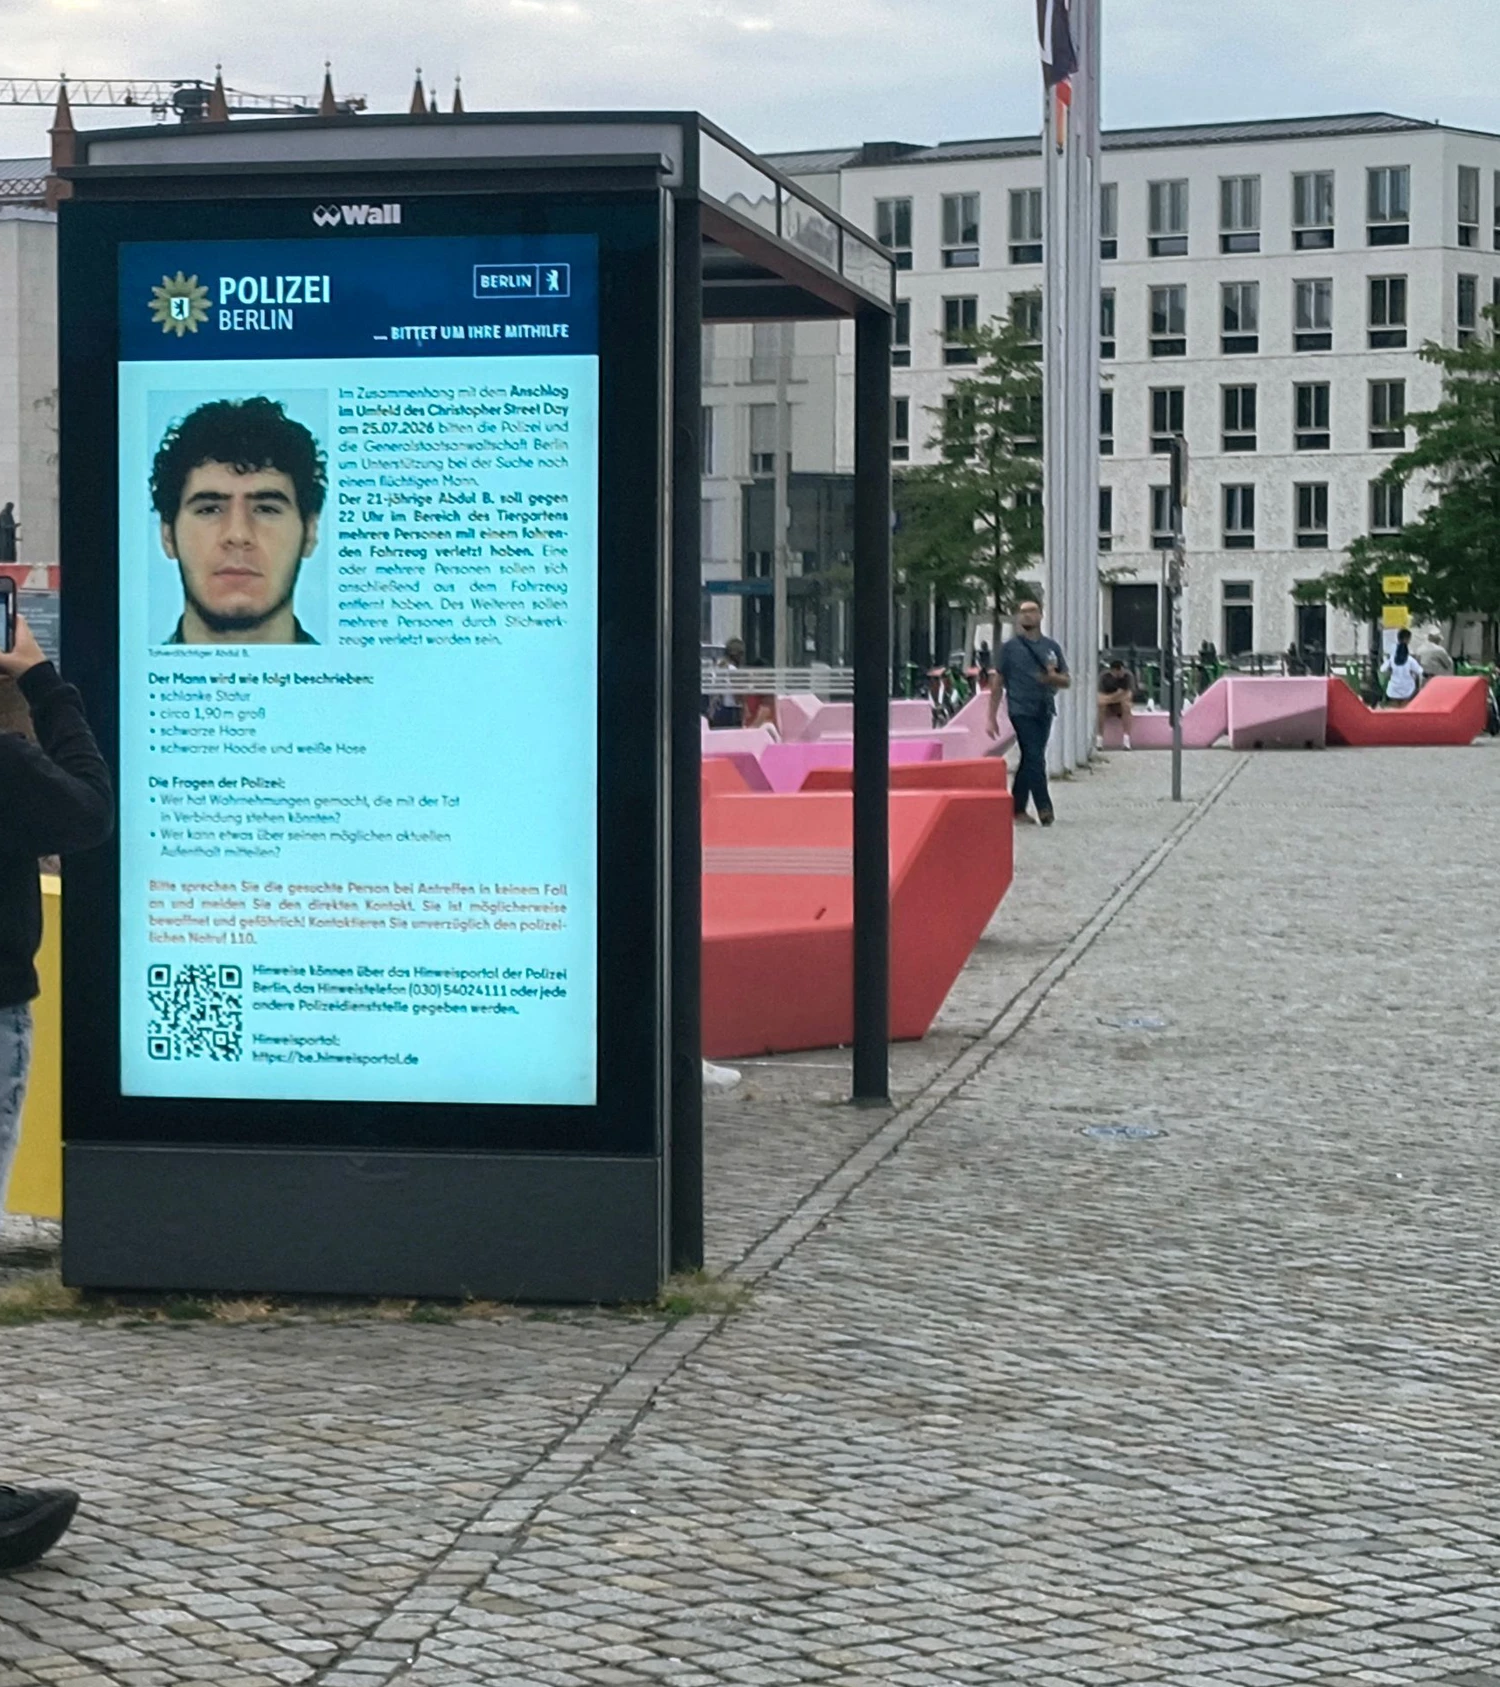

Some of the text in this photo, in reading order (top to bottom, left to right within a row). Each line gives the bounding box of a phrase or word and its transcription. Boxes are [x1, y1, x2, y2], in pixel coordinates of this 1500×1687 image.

[341, 203, 401, 226] Wall
[479, 274, 532, 288] BERLIN
[219, 275, 331, 305] POLIZEI
[219, 309, 293, 331] BERLIN
[391, 326, 437, 340] BITTET
[440, 326, 465, 339] UM
[467, 325, 501, 339] IHRE
[504, 324, 569, 338] MITHILFE
[339, 384, 569, 401] Im Zusammenhang mit dem Anschlag
[338, 402, 569, 418] im Umfeld des Christopher Street Day
[338, 420, 569, 435] am 25.07.2026 bitten die Polizei und
[338, 493, 362, 505] Der
[438, 492, 476, 504] Abdul
[500, 491, 523, 503] soll
[528, 494, 568, 506] gegen
[339, 509, 568, 524] 22 Uhr im Bereich des Tiergartens
[338, 528, 390, 540] mehrere
[394, 527, 452, 540] Personen
[455, 527, 476, 539] mit
[479, 528, 518, 539] einem
[338, 546, 362, 557] den
[369, 545, 427, 560] Fahrzeug
[435, 545, 482, 557] verletzt
[541, 544, 568, 556] Eine
[147, 672, 170, 684] Der
[173, 672, 207, 684] Mann
[209, 673, 236, 684] wird
[238, 673, 259, 684] wie
[262, 672, 291, 687] folgt
[159, 689, 251, 702] schlanke Statur
[159, 708, 190, 719] circa
[159, 725, 257, 736] schwarze Haare
[159, 742, 367, 754] schwarzer Hoodie und weiße Hose
[148, 776, 169, 788] Die
[172, 776, 215, 791] Fragen
[218, 777, 238, 788] der
[159, 828, 451, 844] Wer kann etwas über seinen möglichen aktuellen
[150, 880, 568, 896] Bitte sprechen Sie die gesuchte Person bei Antreffen in keinem Fall
[149, 900, 164, 909] an
[172, 898, 193, 909] und
[202, 898, 245, 910] meiden
[252, 898, 271, 910] Sie
[279, 898, 301, 910] den
[308, 899, 358, 911] direkten
[423, 899, 441, 911] Sie
[448, 900, 462, 911] ist
[470, 900, 567, 915] möglicherweise
[149, 914, 209, 926] bewaffnet
[214, 915, 235, 927] und
[309, 916, 386, 928] Kontaktieren
[389, 917, 407, 928] Sie
[411, 917, 490, 932] unverzüglich
[494, 918, 516, 930] den
[149, 932, 185, 943] lichen
[190, 932, 226, 944] Notruf
[252, 964, 567, 980] Hinweise können über das Hinweisportal der Polizei
[293, 982, 315, 993] das
[317, 983, 406, 994] Hinweistelefon
[510, 985, 538, 997] oder
[539, 986, 567, 1000] jede
[252, 999, 295, 1010] andere
[298, 1000, 409, 1012] Polizeidienststelle
[412, 1002, 468, 1016] gegeben
